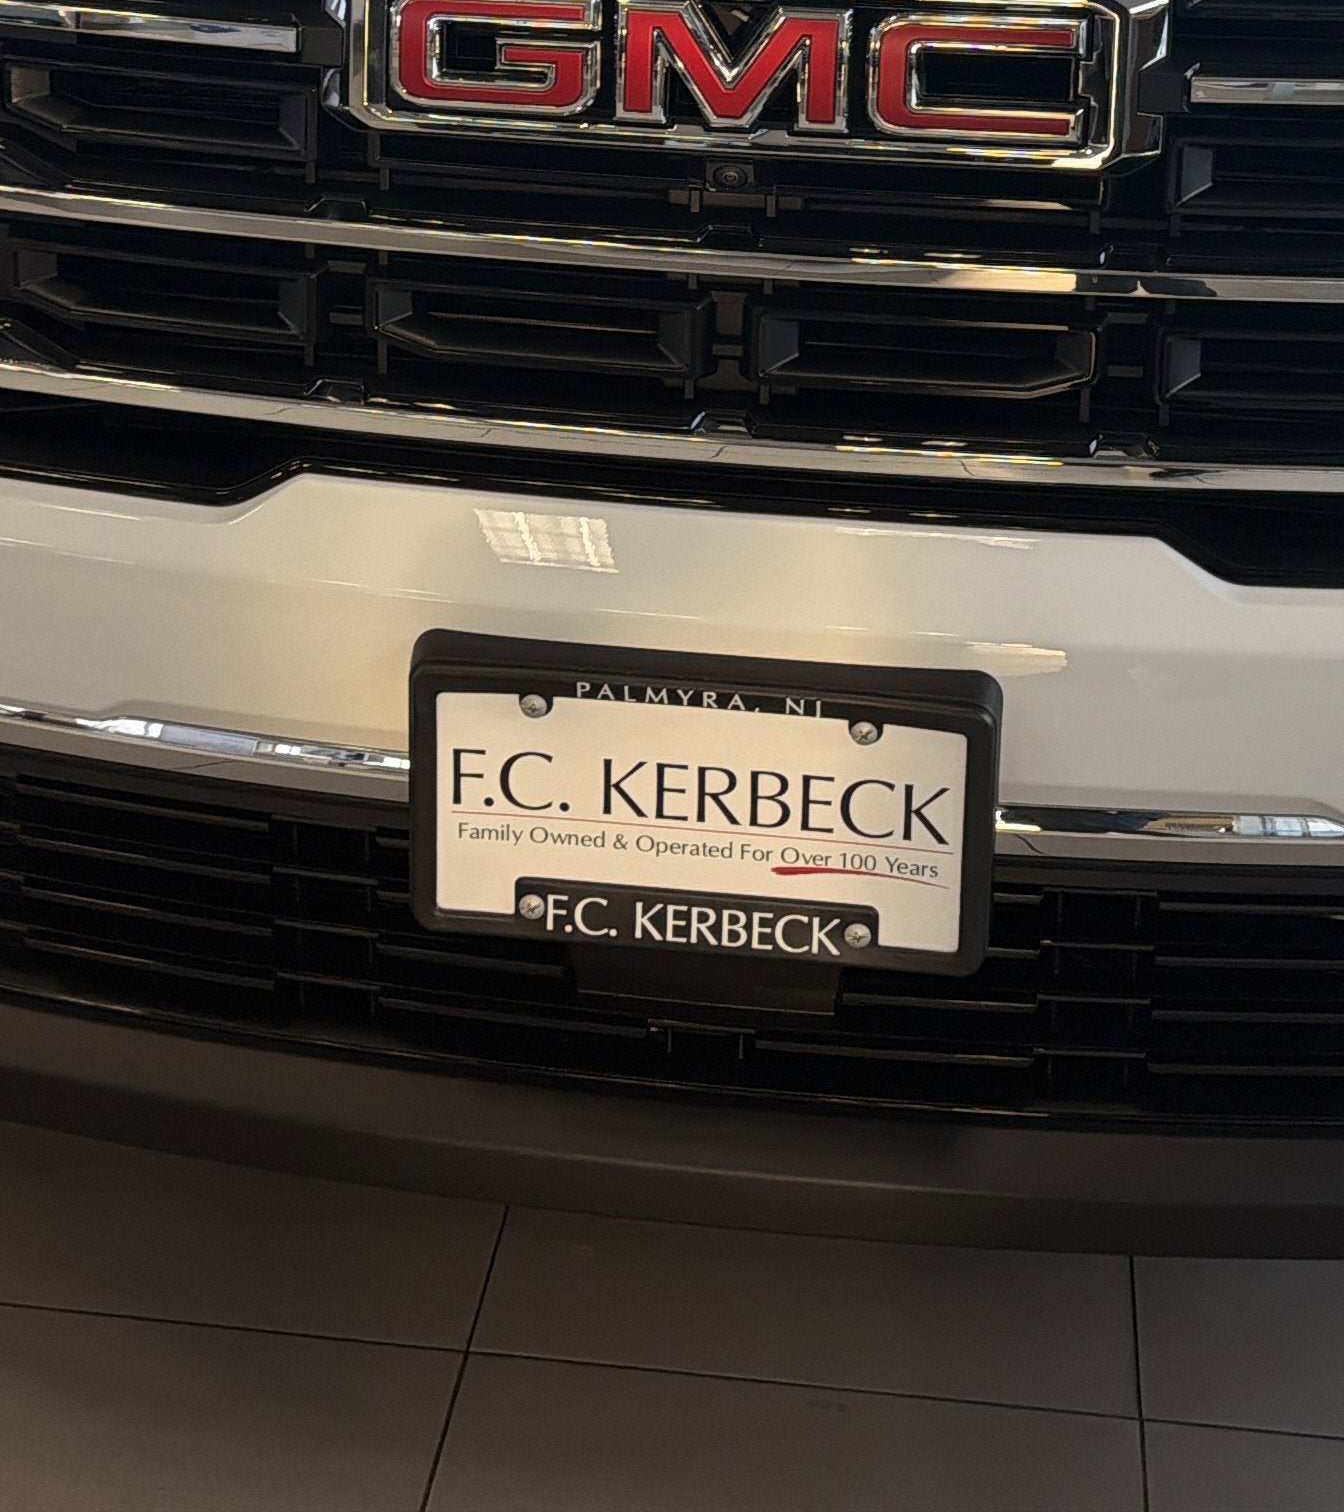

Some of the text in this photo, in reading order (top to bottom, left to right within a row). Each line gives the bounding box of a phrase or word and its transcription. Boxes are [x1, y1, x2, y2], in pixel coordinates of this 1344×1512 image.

[786, 697, 822, 719] NJ
[452, 747, 951, 846] F.C. KERBECK
[458, 822, 939, 879] Family Owned & Operated For Over 100 Years
[546, 894, 841, 956] F.C. KERBECK
